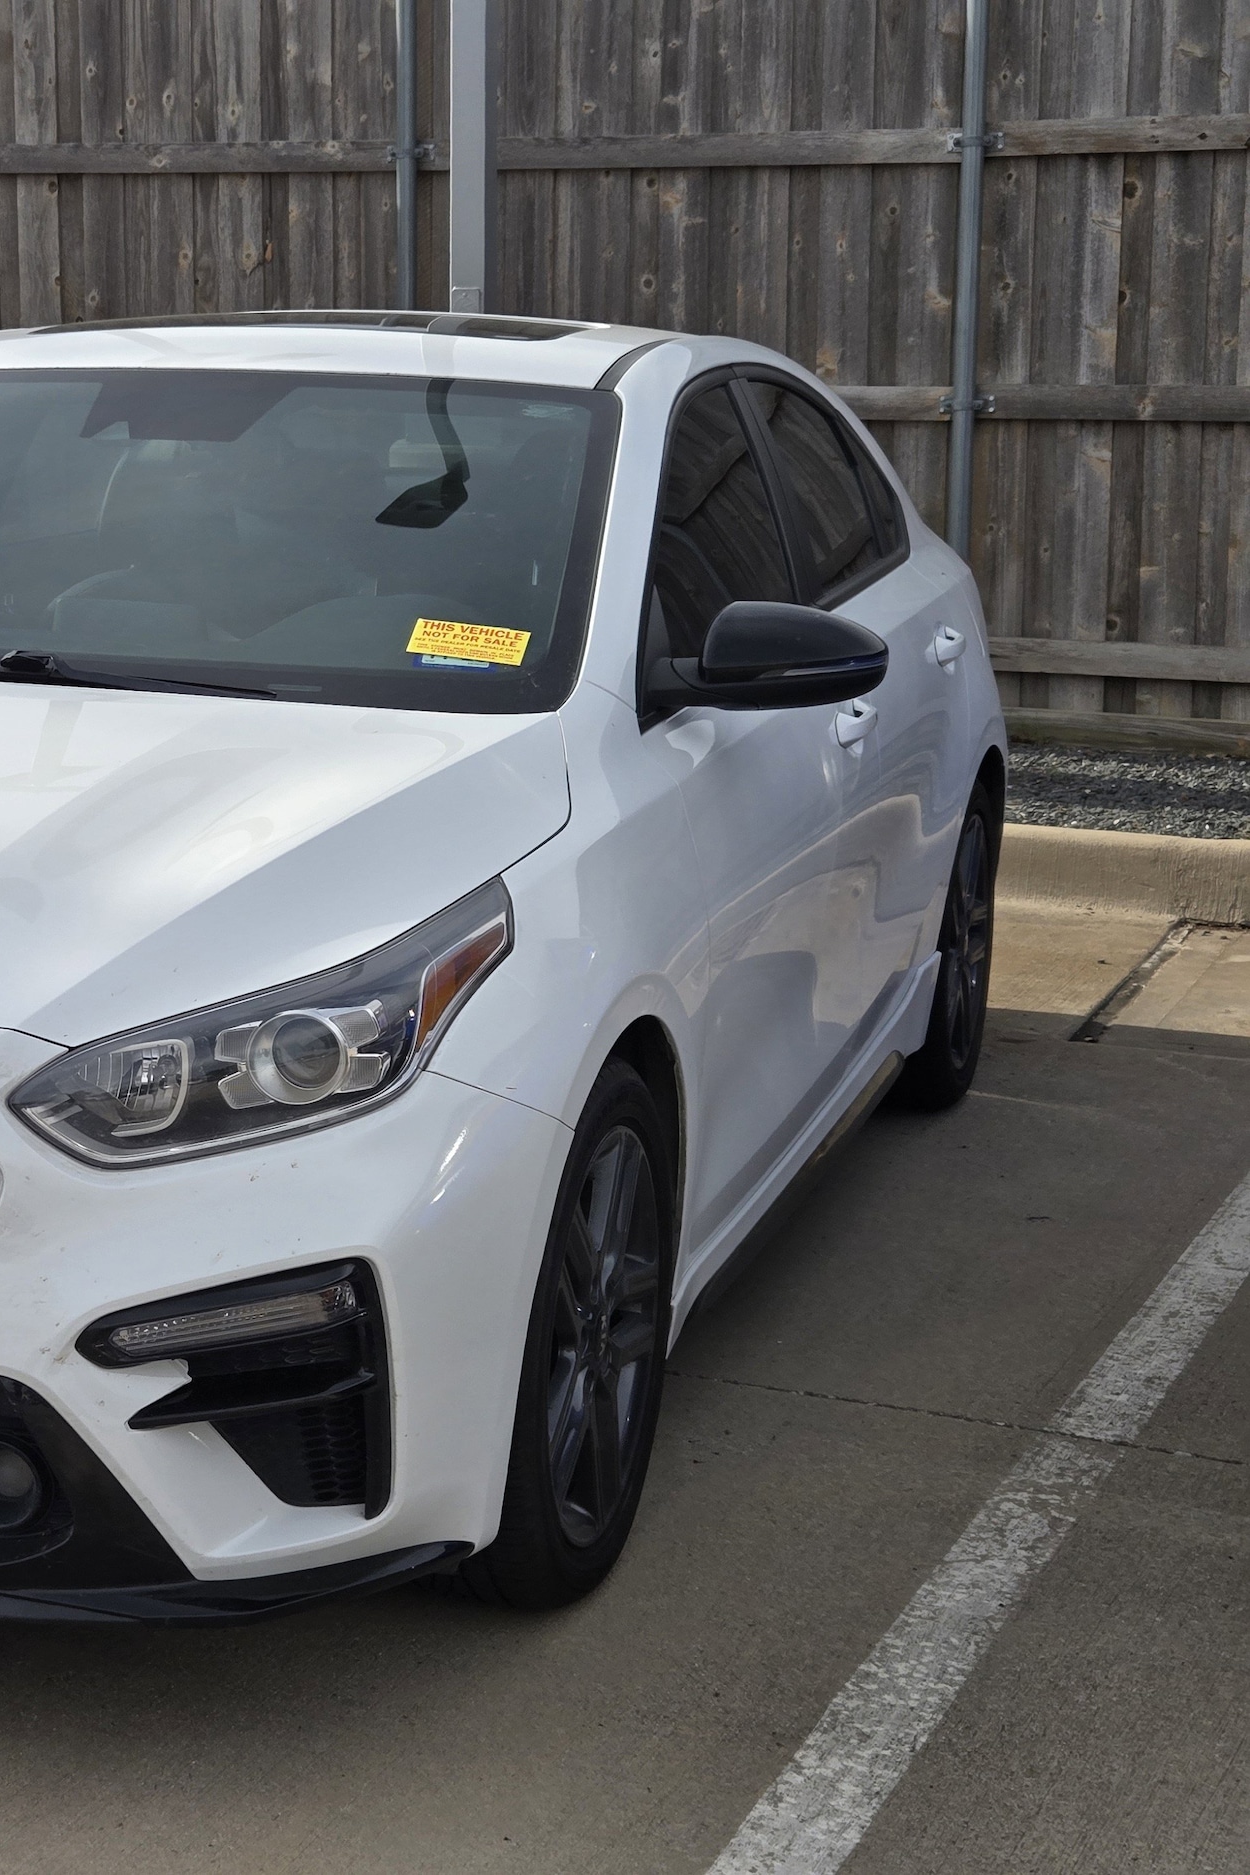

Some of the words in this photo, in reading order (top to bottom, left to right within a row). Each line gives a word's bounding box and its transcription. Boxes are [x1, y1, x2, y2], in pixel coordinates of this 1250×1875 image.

[422, 621, 455, 632] THIS
[460, 625, 525, 641] VEHICLE
[422, 630, 447, 639] NOT
[452, 633, 479, 643] FOR
[484, 637, 519, 648] SALE
